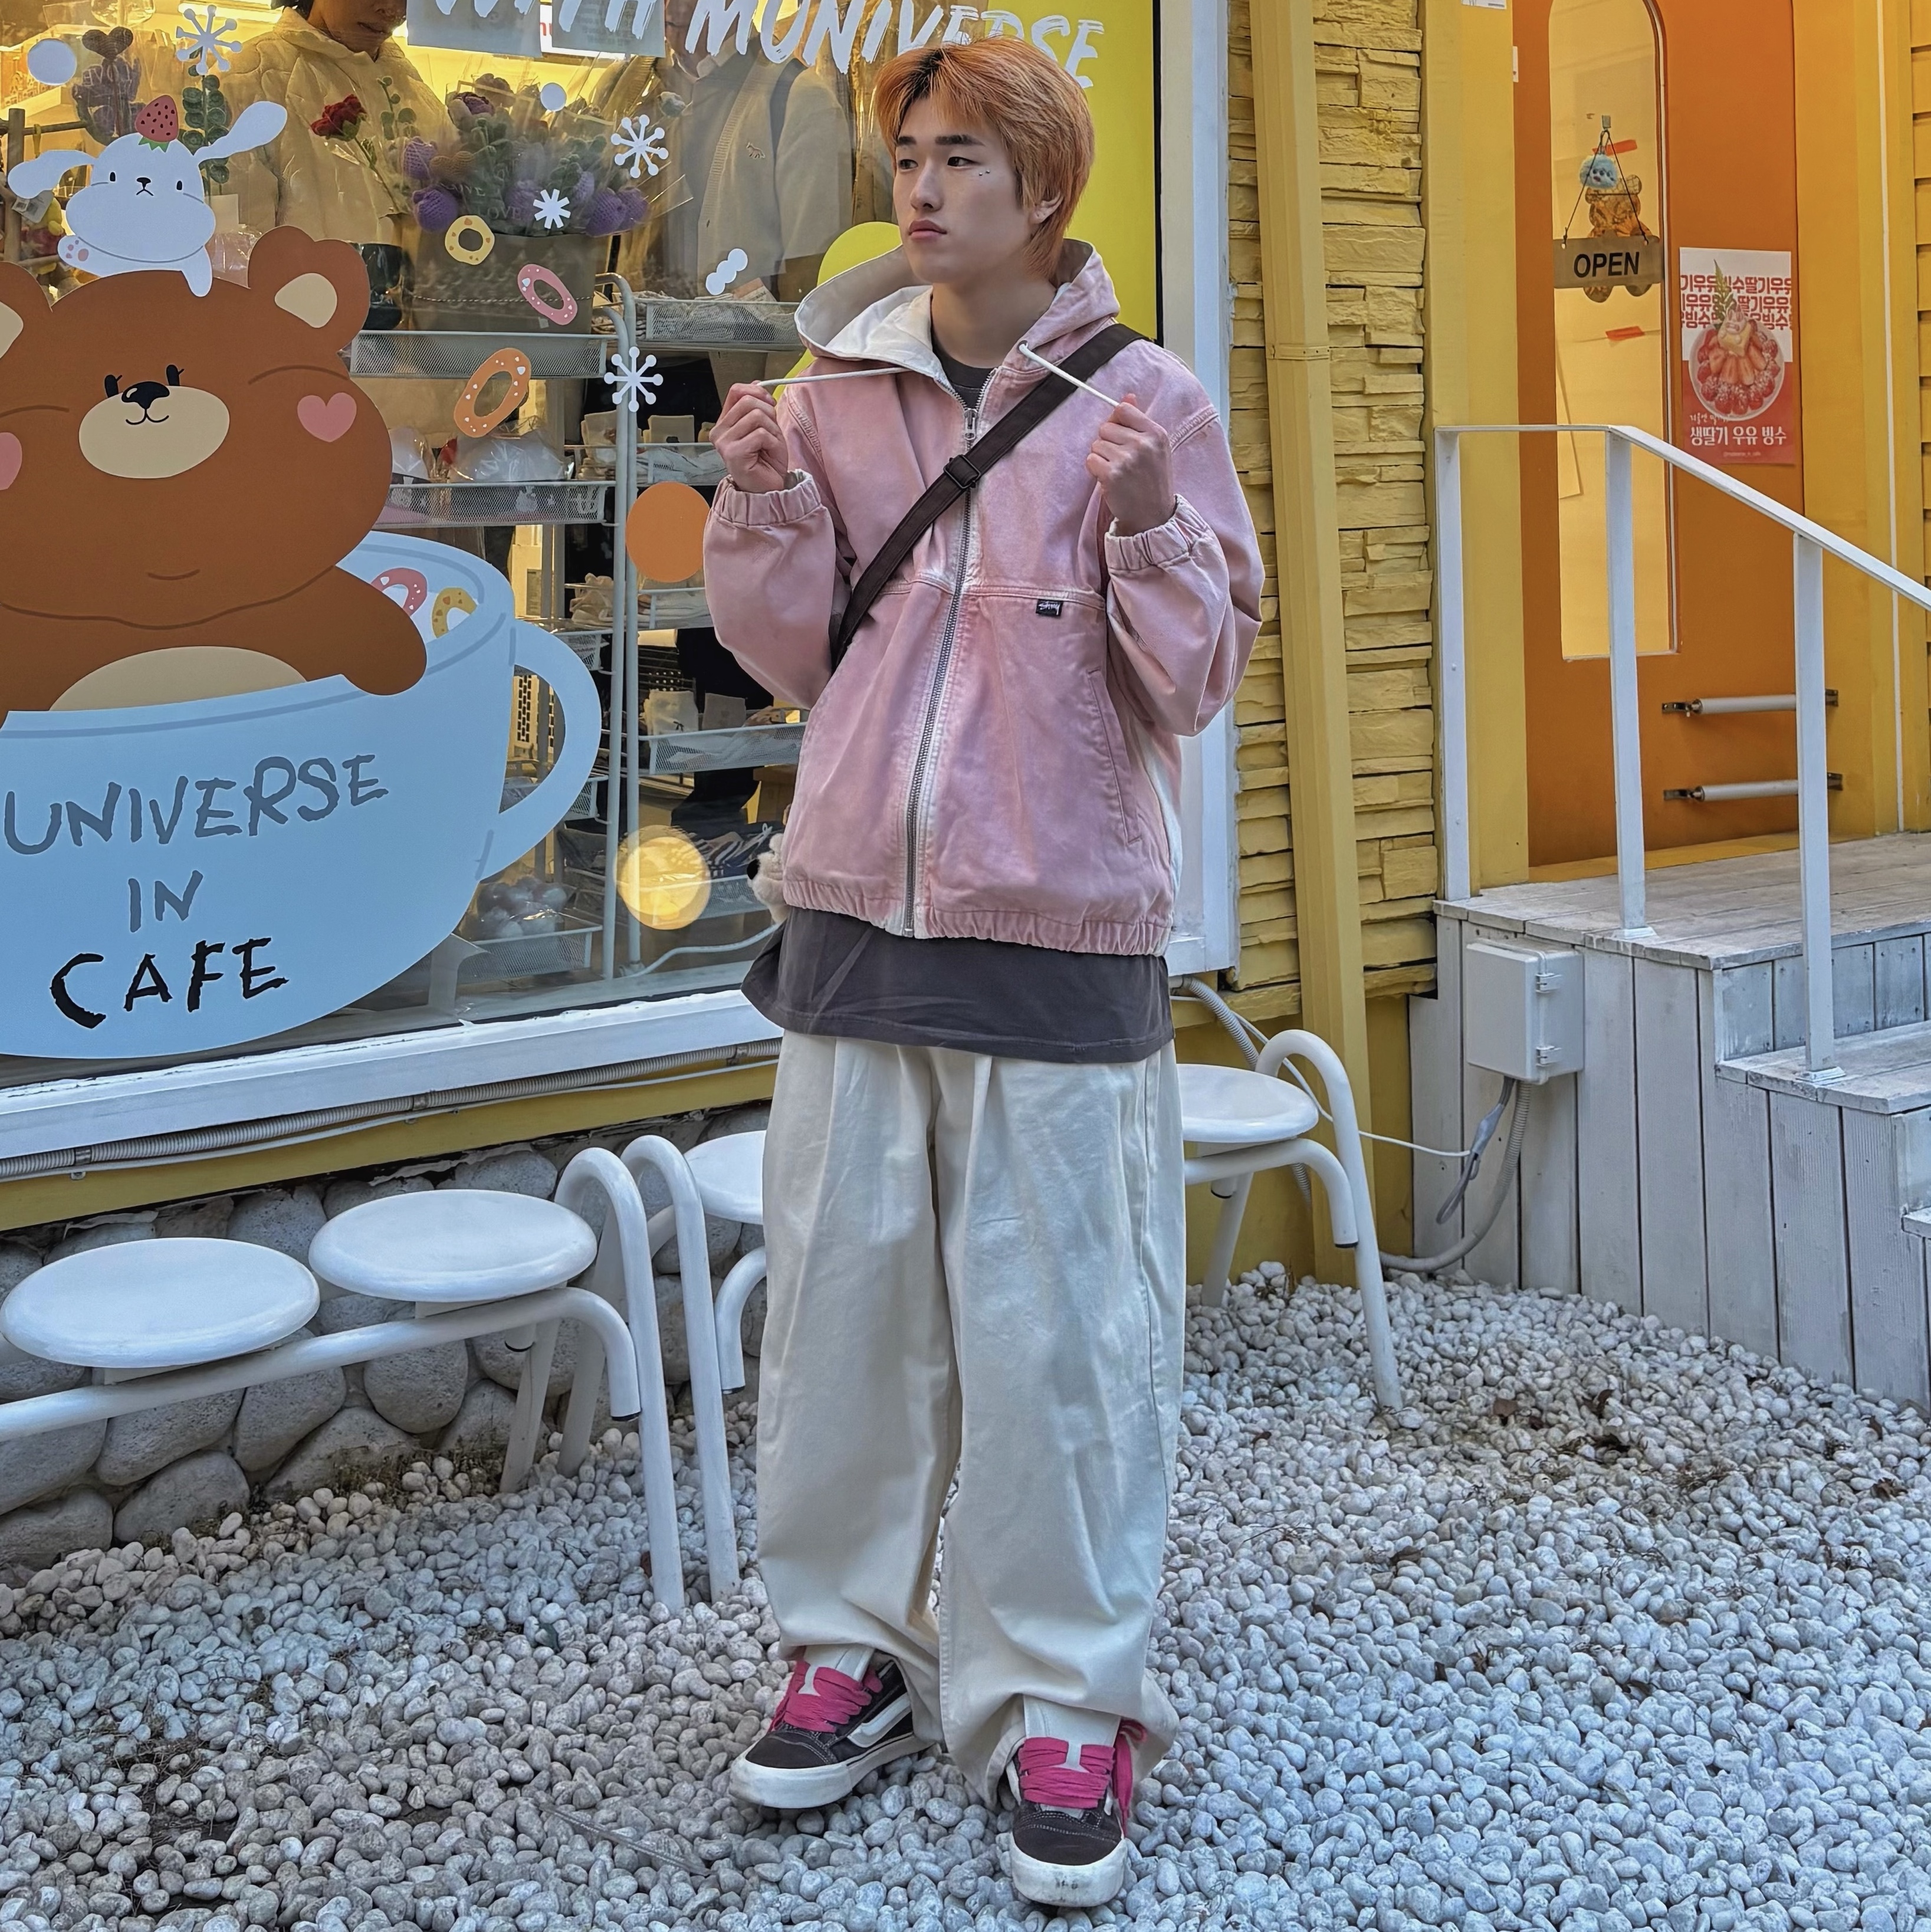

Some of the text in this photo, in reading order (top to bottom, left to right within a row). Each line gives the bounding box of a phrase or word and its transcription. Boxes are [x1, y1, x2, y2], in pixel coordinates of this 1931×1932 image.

[1574, 252, 1640, 278] OPEN
[1690, 426, 1787, 446] 생딸기 우유 빙수
[5, 754, 389, 855] UNIVERSE
[128, 870, 203, 932] IN
[50, 937, 290, 1029] CAFE
